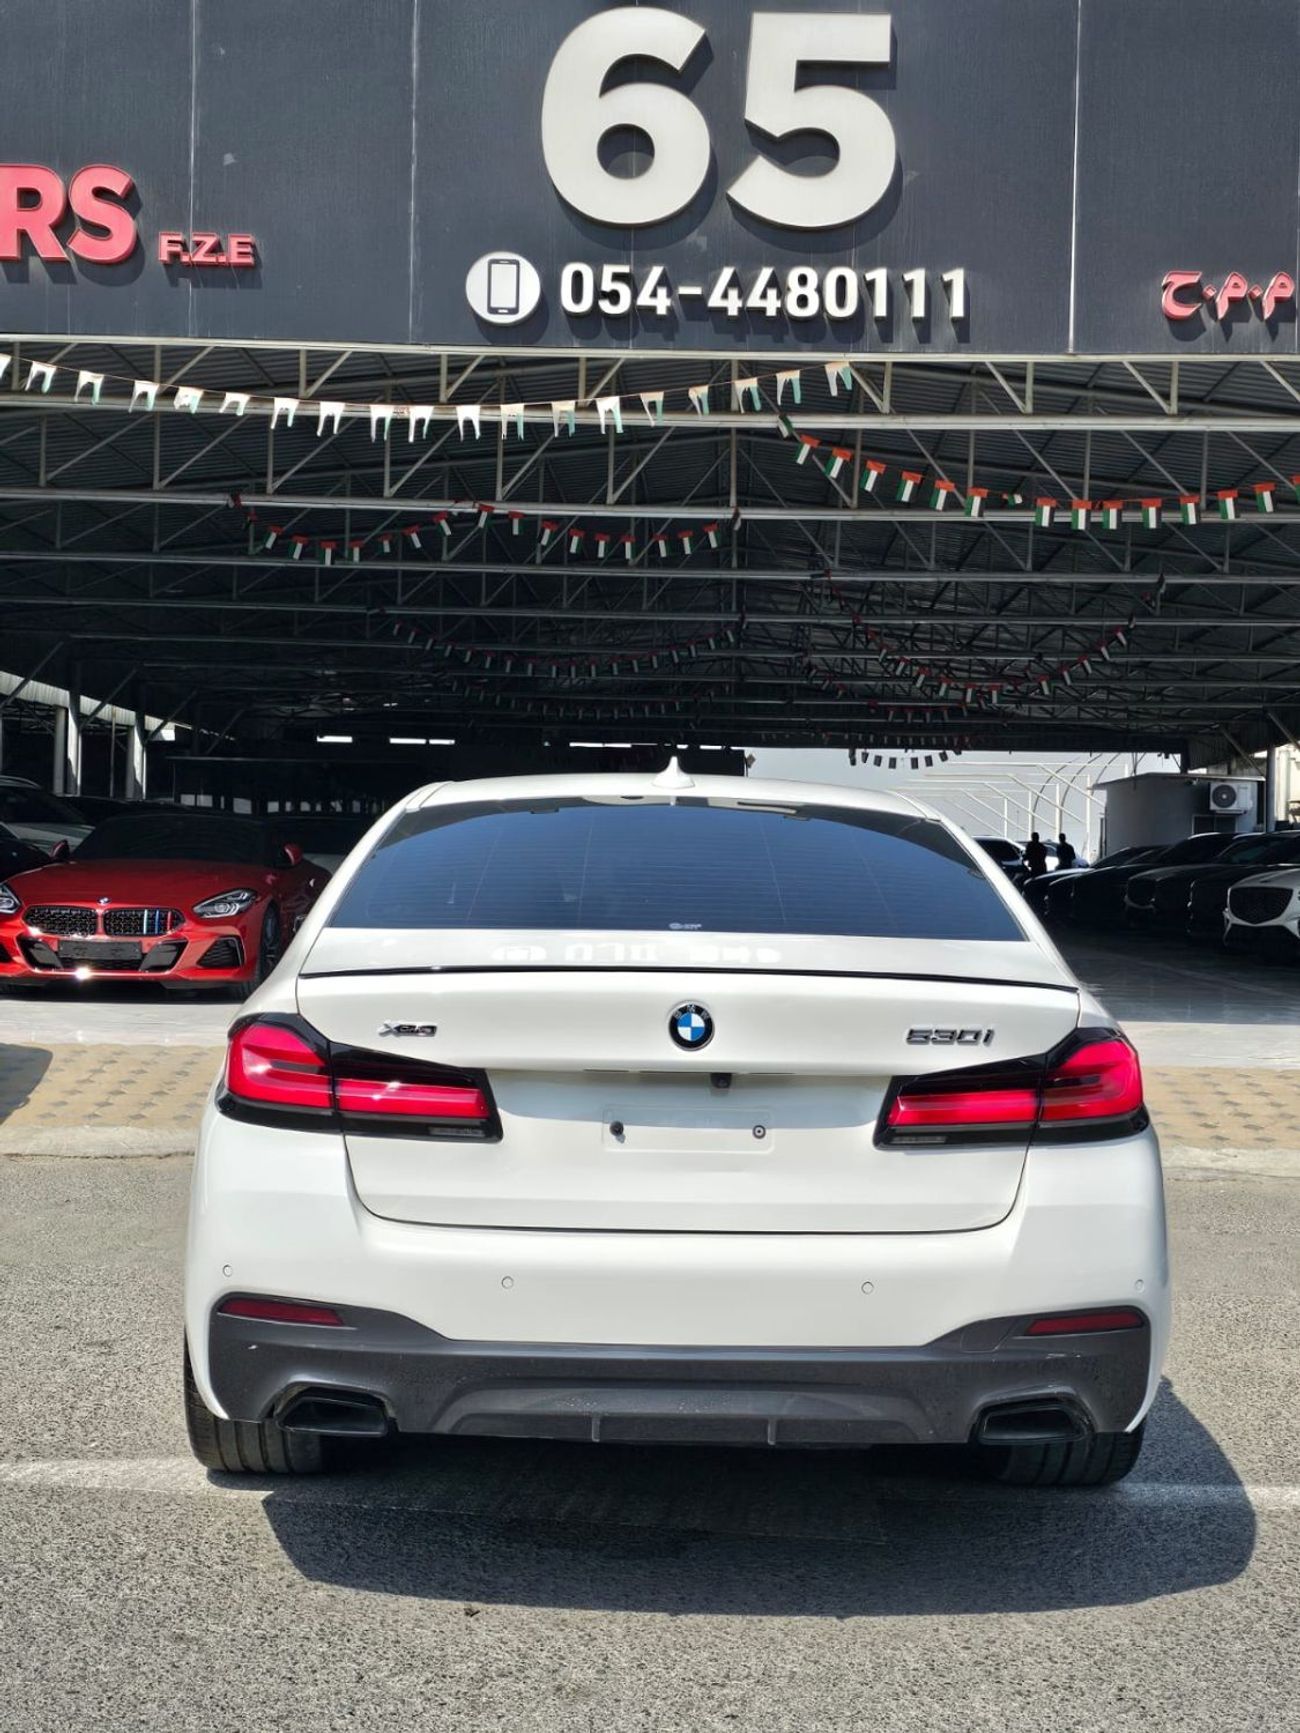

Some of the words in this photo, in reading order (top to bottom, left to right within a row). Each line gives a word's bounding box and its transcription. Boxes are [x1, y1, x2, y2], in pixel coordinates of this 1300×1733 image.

[541, 6, 896, 228] 65
[158, 232, 255, 267] F.Z.E
[560, 262, 965, 322] 054-4480111
